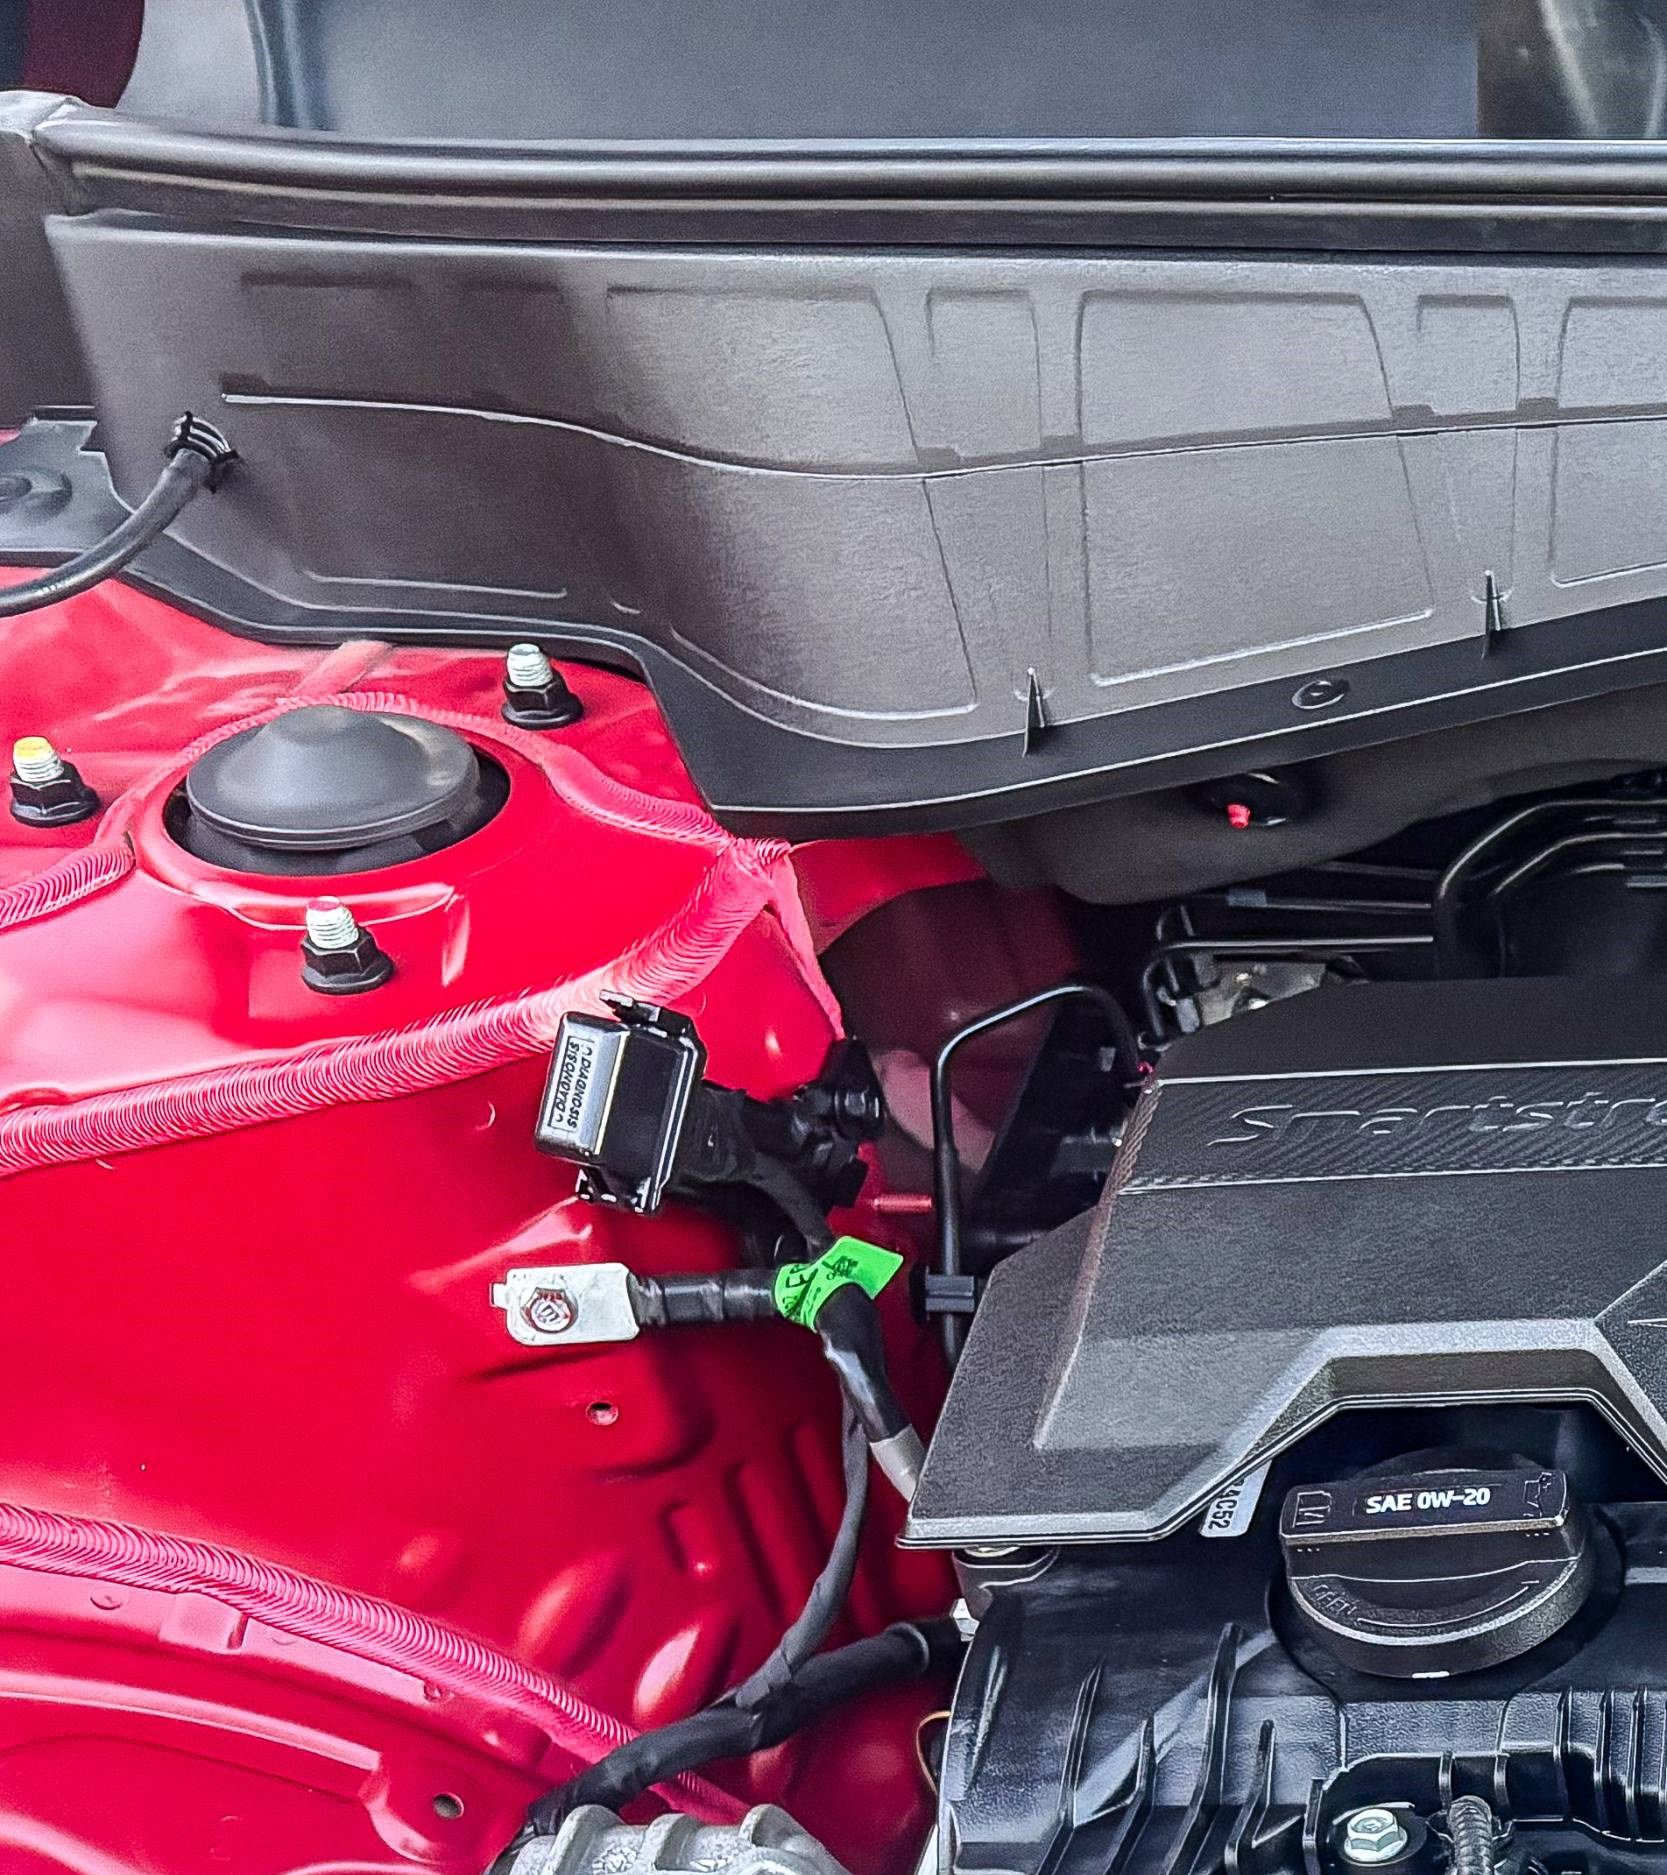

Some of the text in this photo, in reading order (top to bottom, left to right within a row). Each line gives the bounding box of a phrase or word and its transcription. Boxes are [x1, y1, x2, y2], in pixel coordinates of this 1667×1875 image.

[555, 1041, 580, 1113] DIAGNOSIS
[567, 1057, 592, 1128] DIAGNOSIS
[1365, 1487, 1490, 1514] SAE 0W-20
